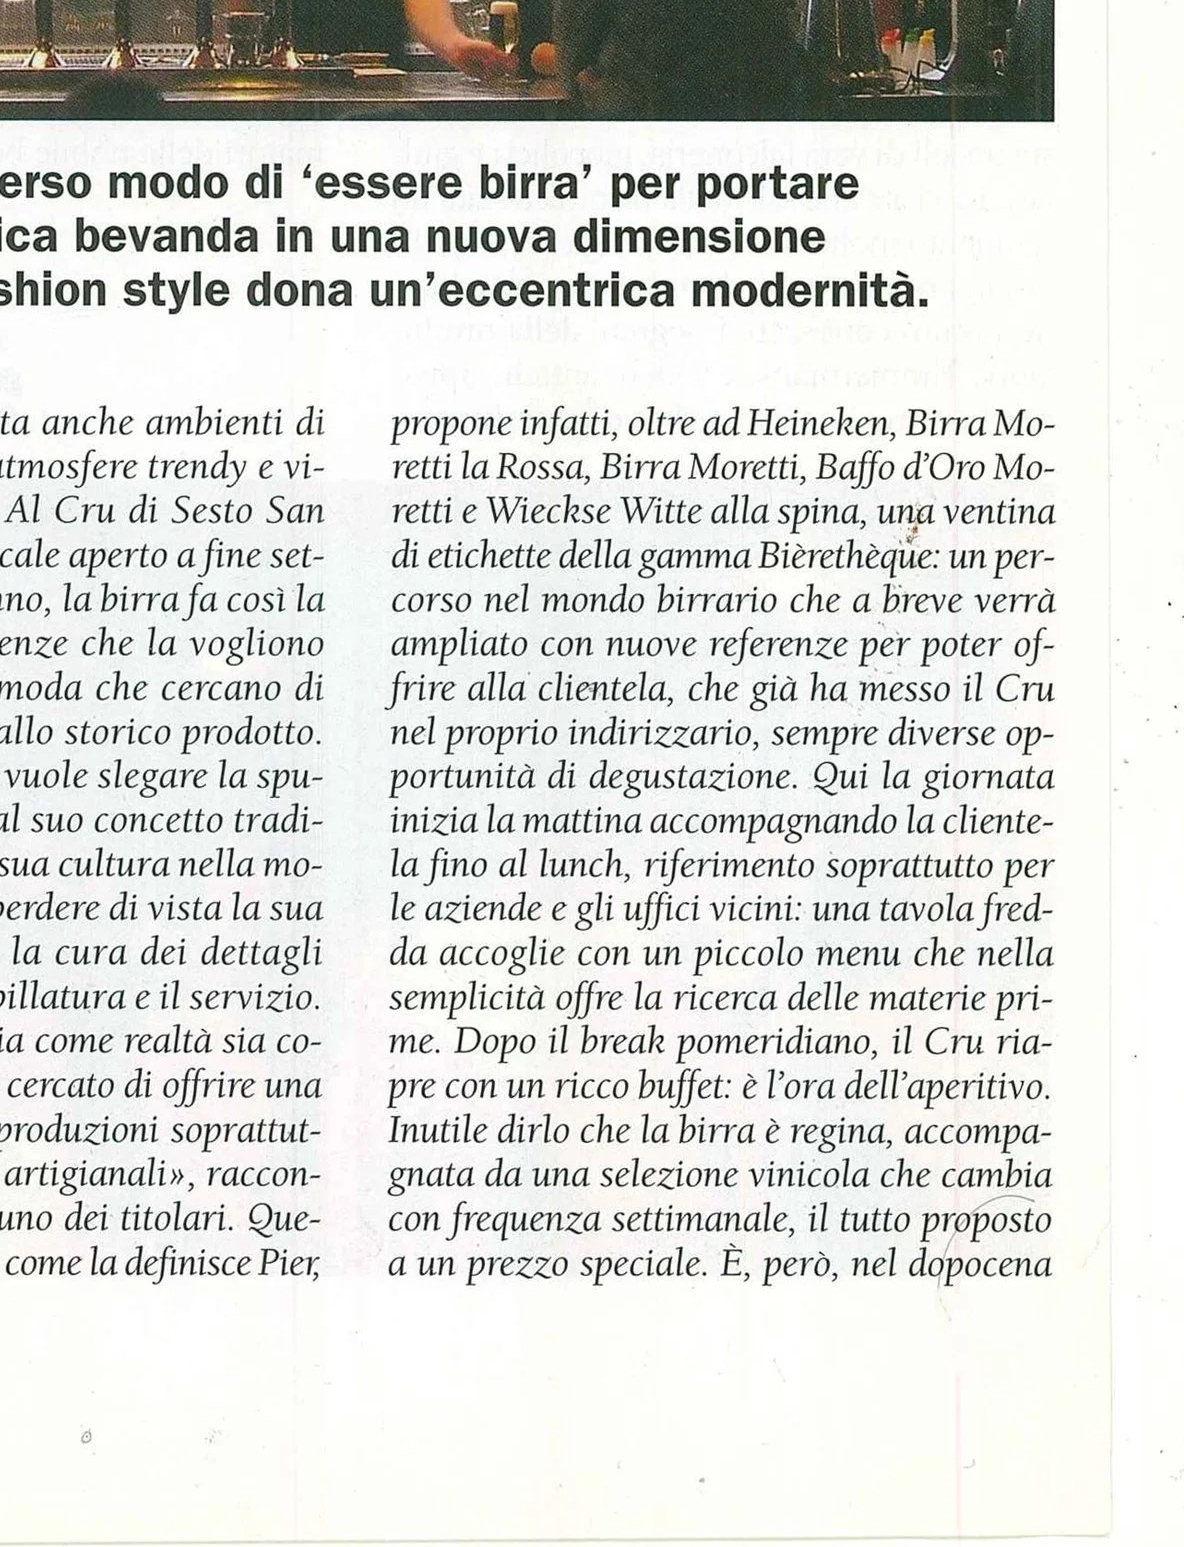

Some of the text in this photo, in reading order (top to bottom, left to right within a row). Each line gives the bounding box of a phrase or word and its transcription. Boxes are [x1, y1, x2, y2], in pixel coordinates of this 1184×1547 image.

[109, 163, 229, 199] modo
[245, 162, 283, 199] di
[302, 163, 462, 200] ‘essere
[480, 163, 592, 200] birra’
[611, 172, 681, 208] per
[697, 165, 859, 208] portare
[75, 216, 258, 253] bevanda
[276, 216, 313, 253] in
[331, 225, 410, 253] una
[427, 225, 557, 254] nuova
[573, 217, 826, 254] dimensione
[123, 270, 230, 315] style
[246, 270, 353, 307] dona
[370, 270, 675, 308] un’eccentrica
[692, 270, 928, 308] modernità.
[42, 405, 134, 436] anche
[145, 405, 283, 436] ambienti
[296, 405, 325, 436] di
[390, 405, 1055, 446] propone infatti, oltre ad Heineken, Birra Mo-
[148, 449, 247, 488] trendy
[258, 459, 274, 480] e
[283, 453, 325, 480] vi-
[392, 449, 1055, 490] retti la Rossa, Birra Moretti, Baffo d’Oro Mo-
[3, 493, 40, 524] Al
[55, 495, 116, 524] Cru
[128, 493, 158, 524] di
[171, 495, 253, 524] Sesto
[266, 495, 325, 524] San
[391, 537, 1055, 580] di etichette della gamma Bièrethèque: un per-
[81, 626, 134, 657] che
[147, 626, 177, 656] la
[189, 626, 324, 667] vogliono
[391, 626, 1055, 668] ampliato con nuove referenze per poter of-
[4, 758, 89, 789] vuole
[97, 758, 208, 799] slegare
[219, 758, 248, 789] la
[256, 769, 323, 799] spu-
[390, 803, 1054, 844] inizia la mattina accompagnando la cliente-
[109, 890, 138, 921] di
[147, 894, 223, 921] vista
[232, 891, 261, 921] la
[269, 901, 324, 921] sua
[389, 1024, 1053, 1065] me. Dopo il break pomeridiano, il Cru ria-
[170, 1118, 321, 1153] soprattut-
[388, 1242, 1053, 1287] a un prezzo speciale. È, però, nel dopocena
